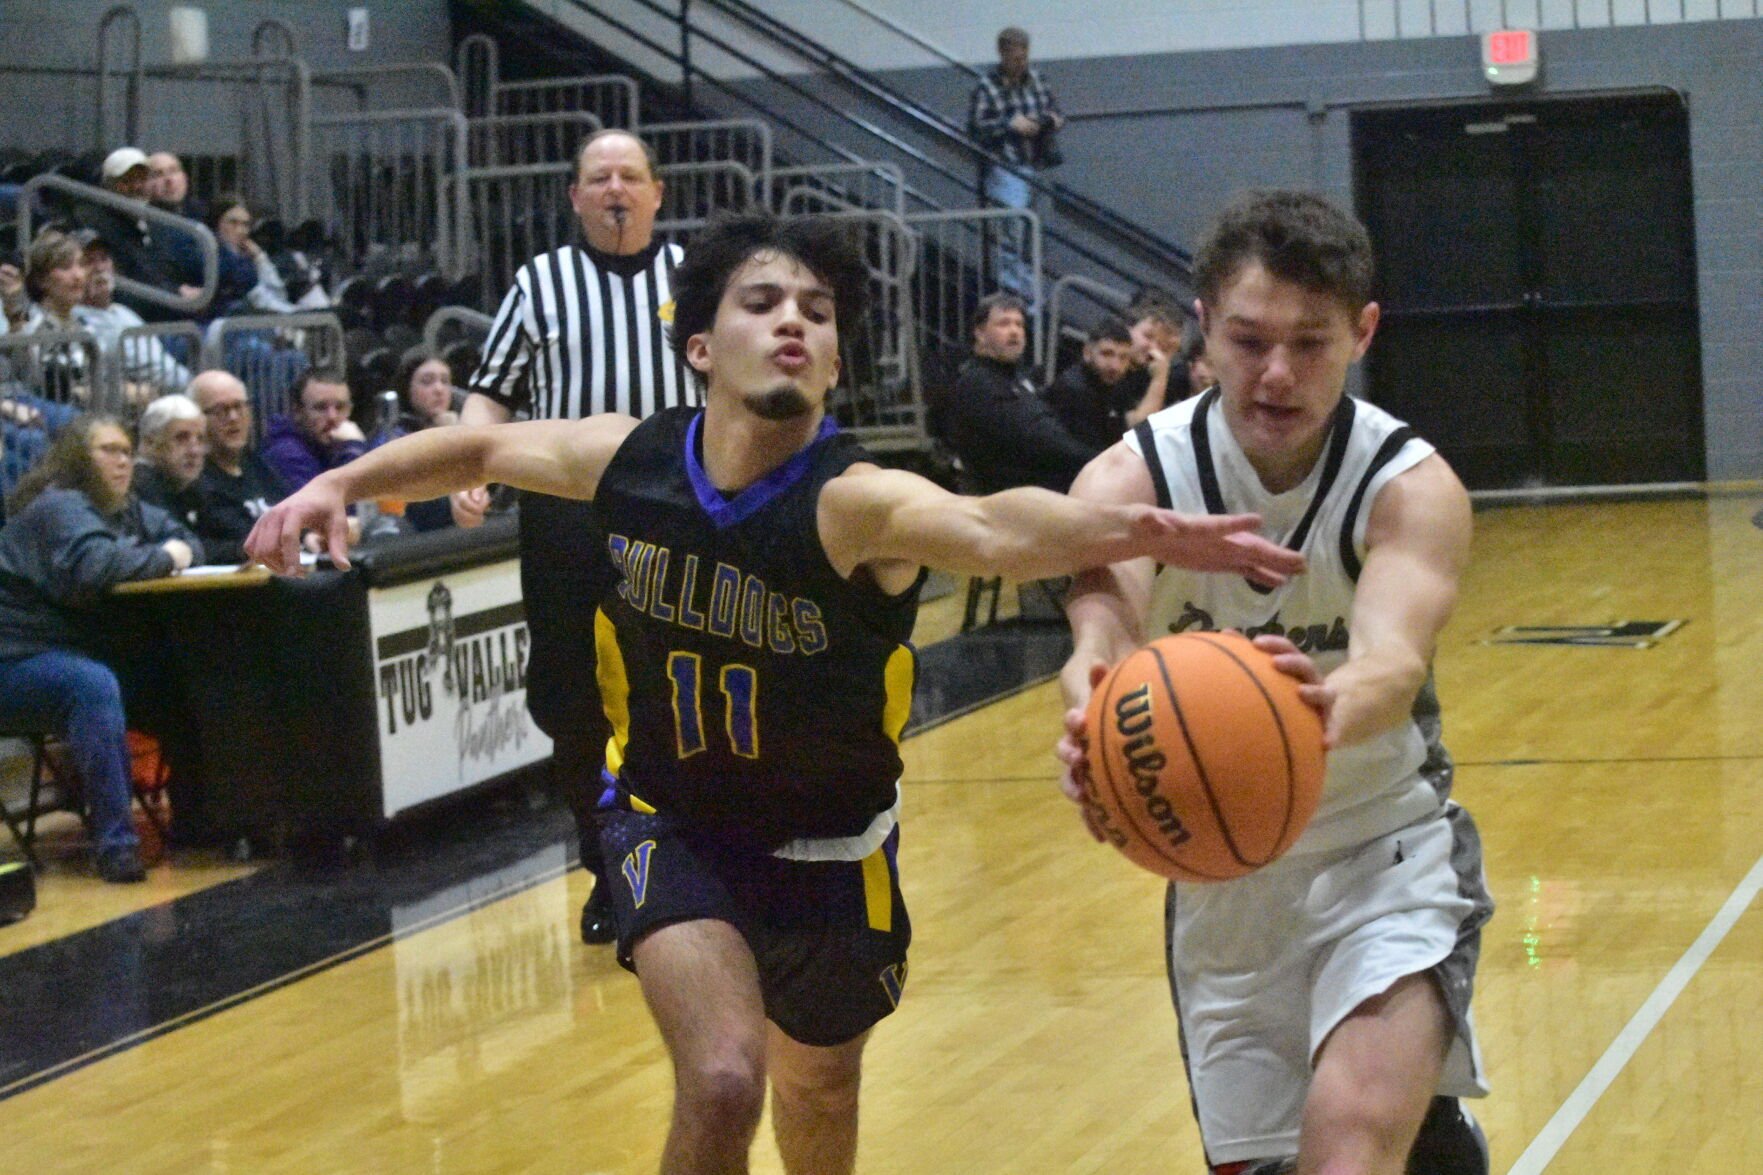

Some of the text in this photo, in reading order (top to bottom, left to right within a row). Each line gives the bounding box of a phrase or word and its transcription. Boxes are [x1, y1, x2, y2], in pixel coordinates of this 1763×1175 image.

[380, 625, 530, 735] TUG VALLE
[667, 650, 759, 760] 11
[1114, 682, 1192, 847] Wilson
[621, 839, 657, 910] V
